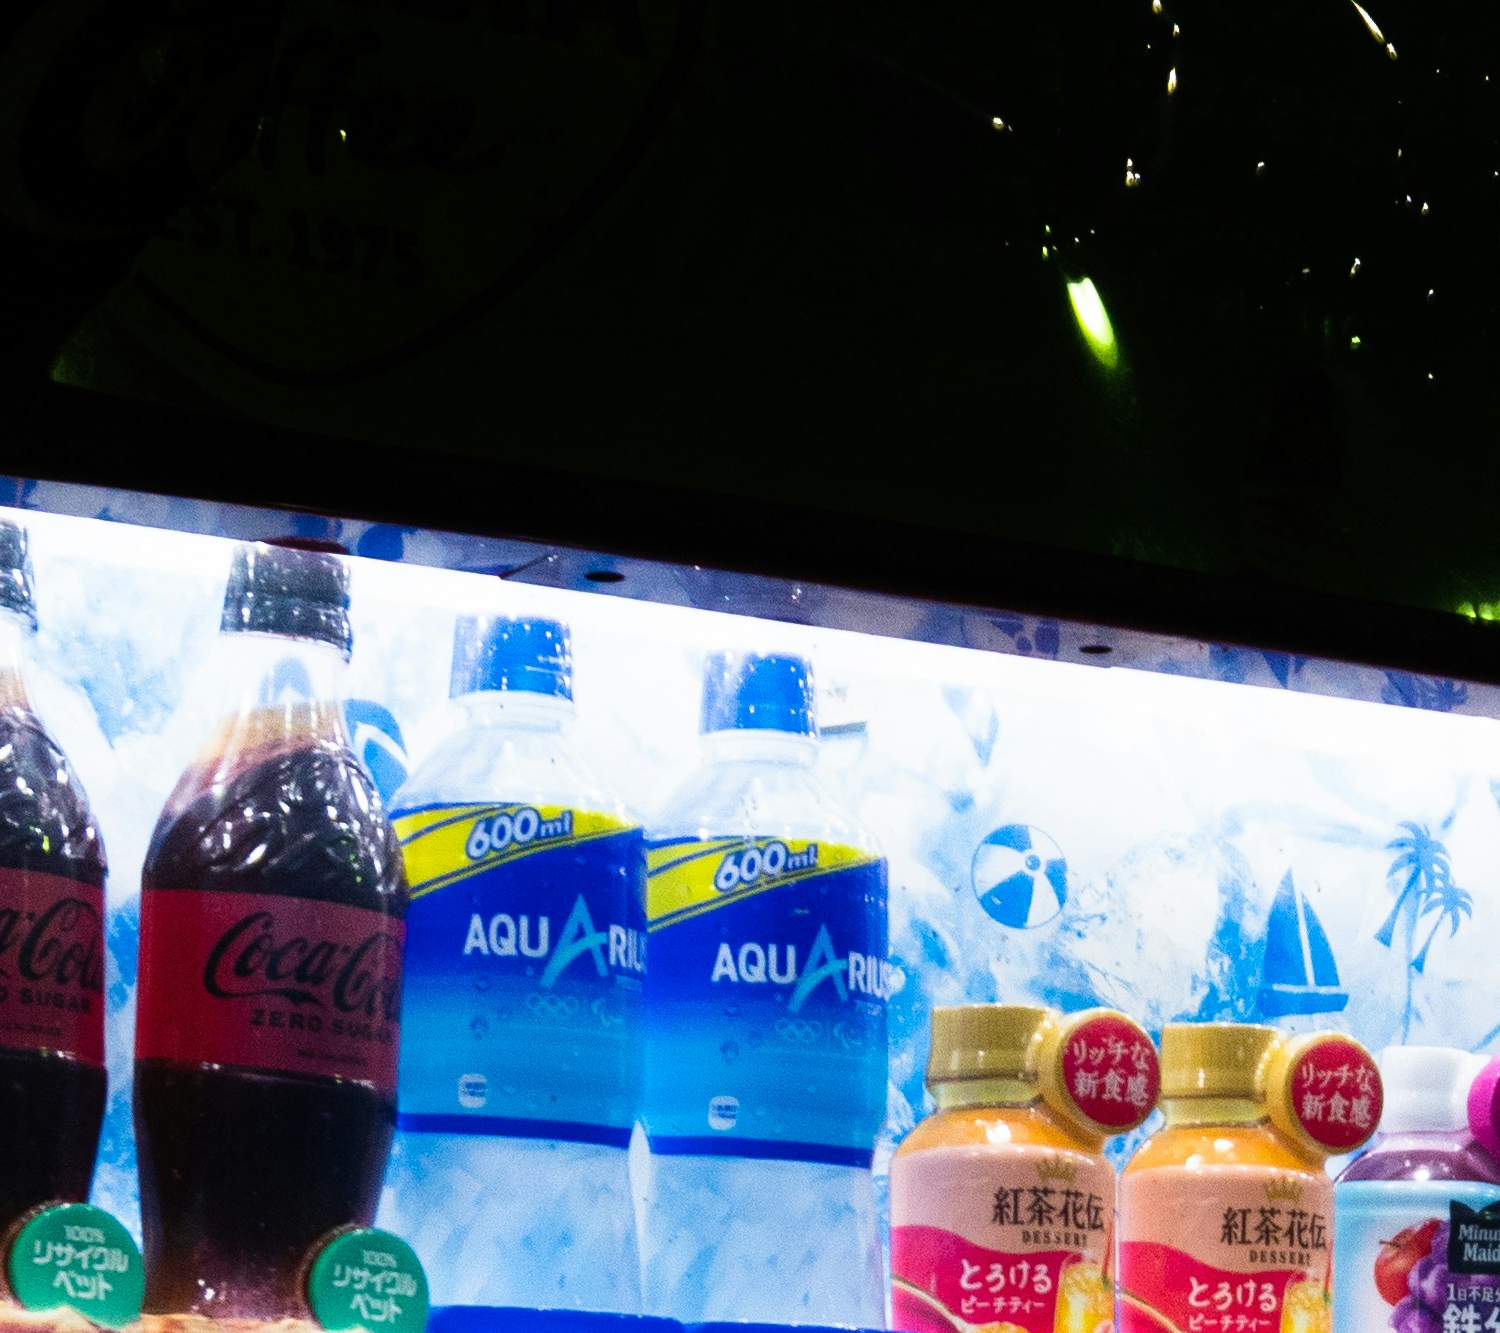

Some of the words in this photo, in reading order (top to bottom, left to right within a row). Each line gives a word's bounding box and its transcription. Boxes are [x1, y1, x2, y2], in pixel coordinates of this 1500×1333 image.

[286, 209, 424, 289] 1975
[466, 807, 573, 860] 600ml
[715, 842, 818, 892] 600ml
[1071, 1037, 1150, 1075] リッチな
[1074, 1069, 1147, 1107] 新食感
[992, 1186, 1104, 1231] 紅茶花伝
[1220, 1205, 1327, 1250] 紅茶花伝
[960, 1260, 1053, 1295] とろける
[961, 1296, 1046, 1316] ピーチティー
